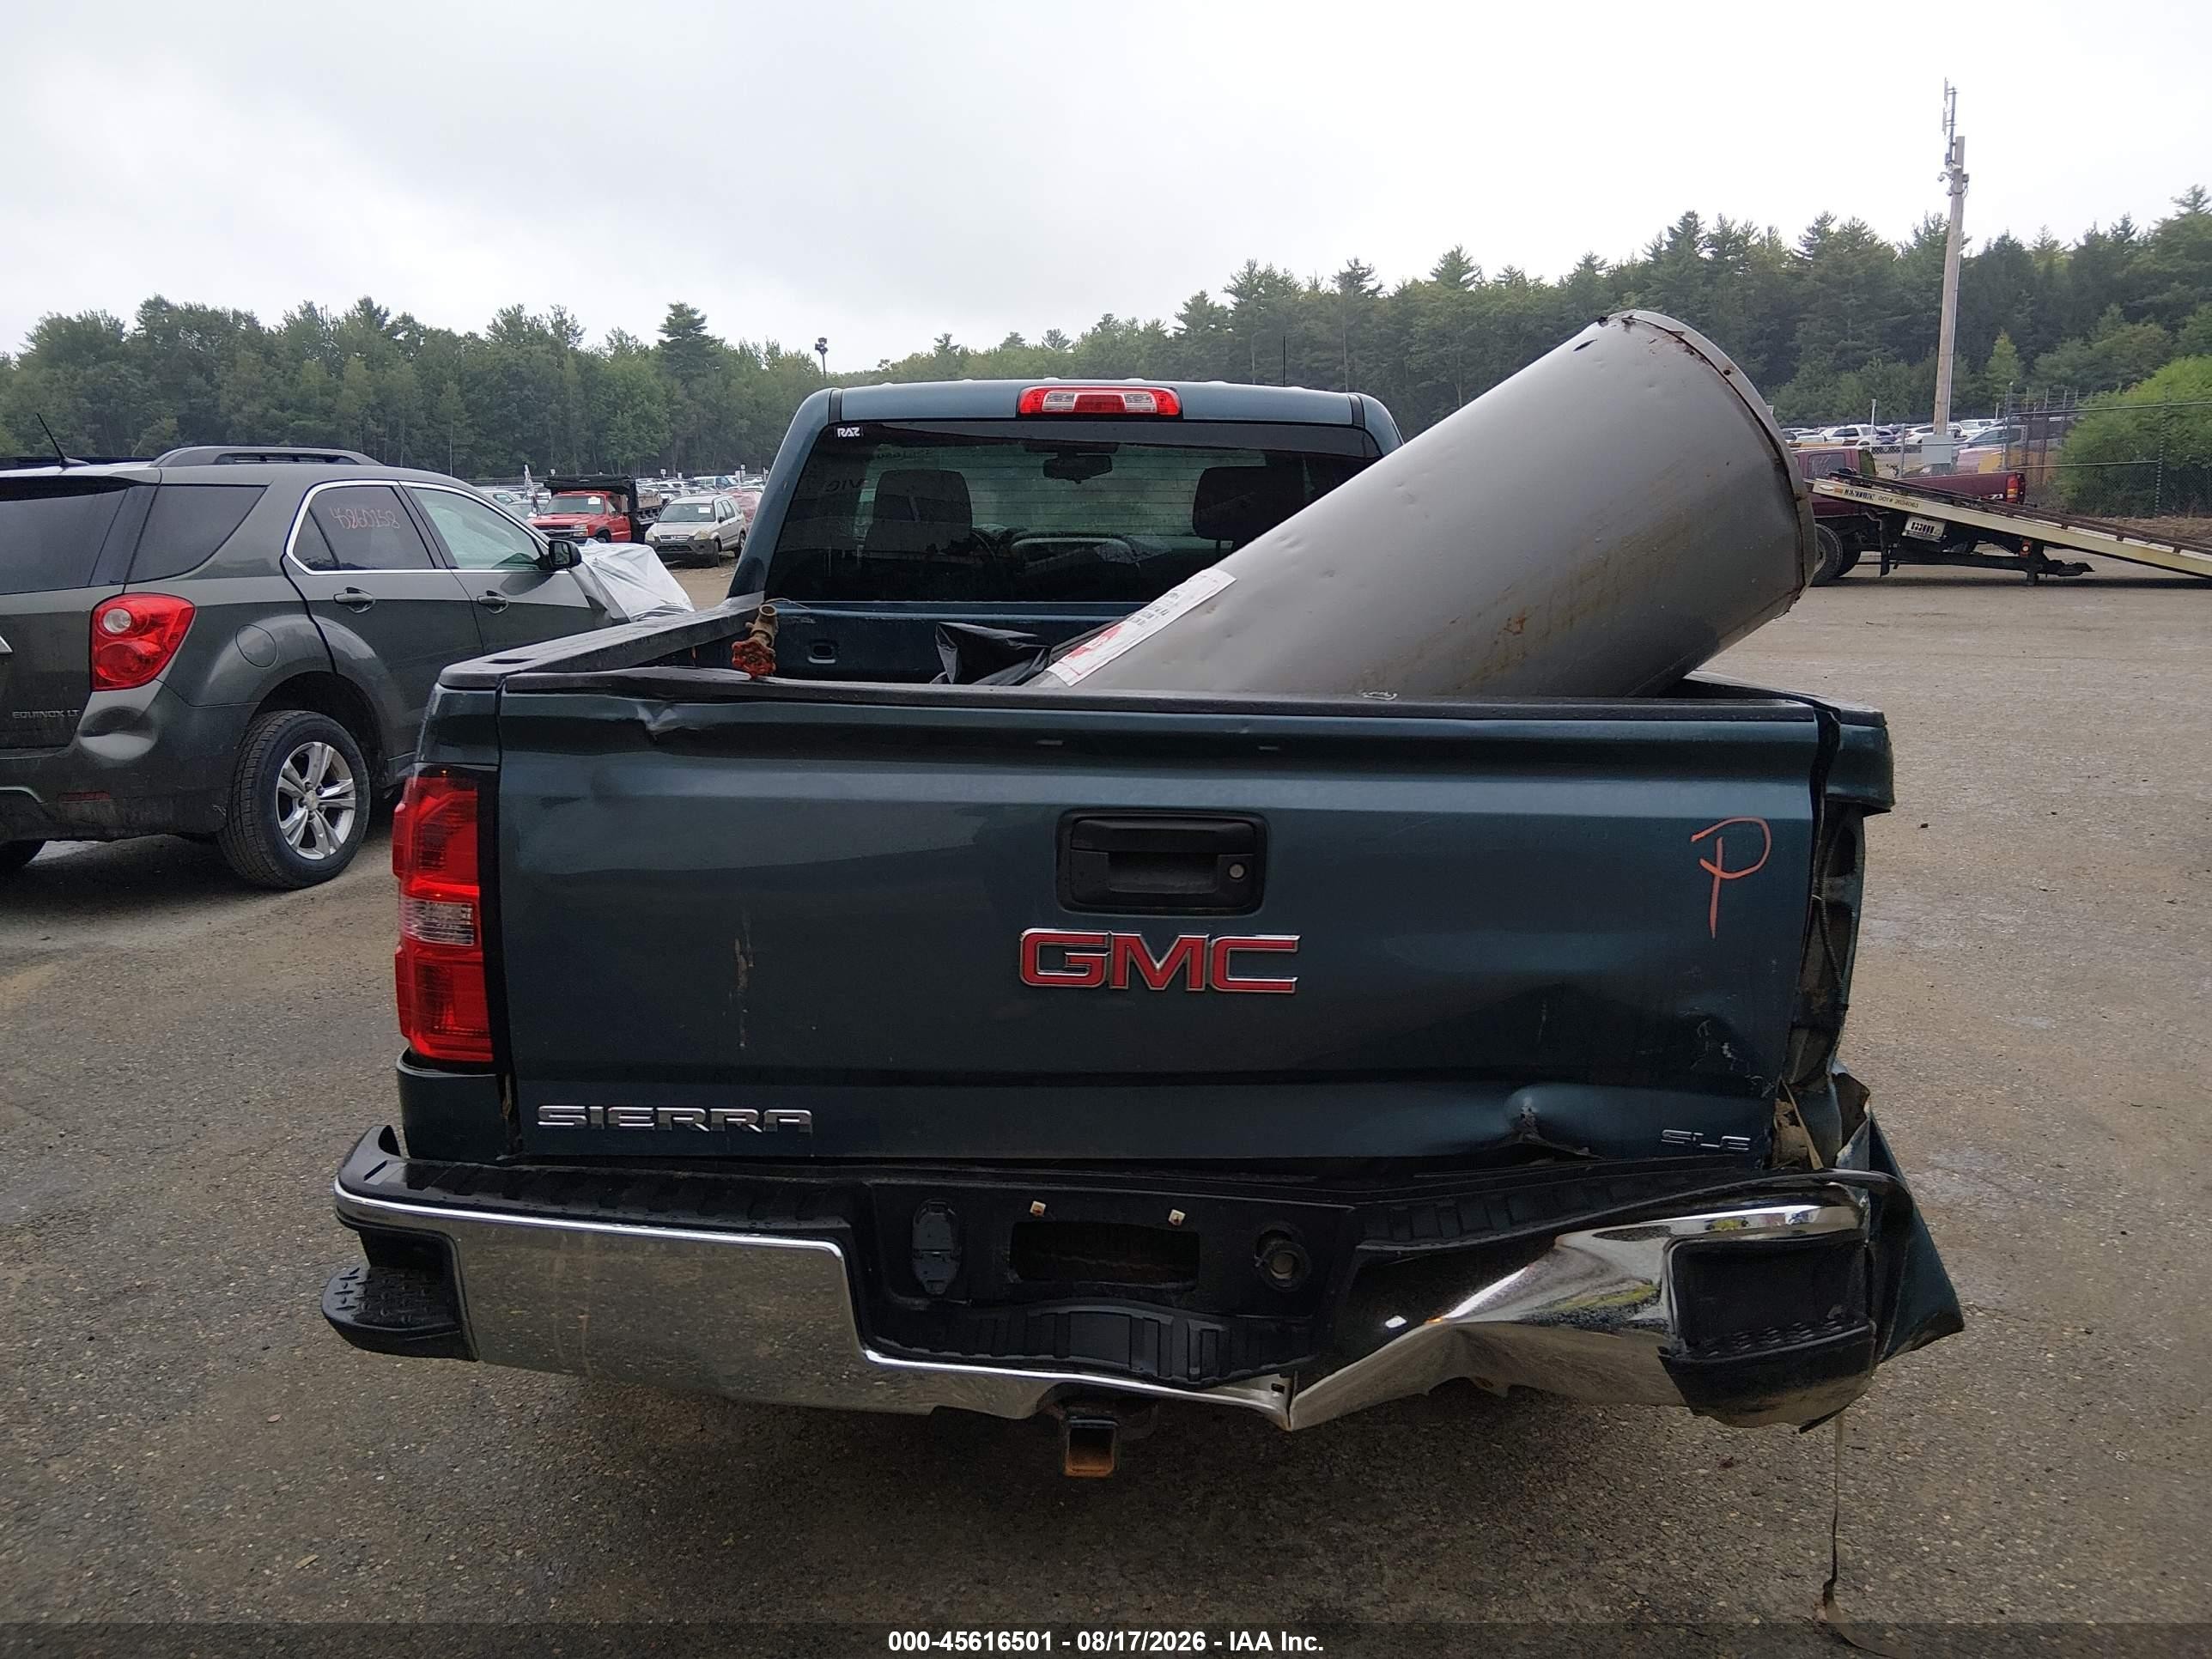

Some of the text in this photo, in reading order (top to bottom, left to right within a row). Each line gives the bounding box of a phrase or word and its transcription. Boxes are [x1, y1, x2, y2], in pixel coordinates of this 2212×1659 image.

[12, 709, 81, 719] EQUINOX LT
[1690, 816, 1771, 939] P
[1019, 928, 1301, 994] GMC
[538, 1105, 813, 1133] SIERRA
[1661, 1129, 1751, 1152] SLE
